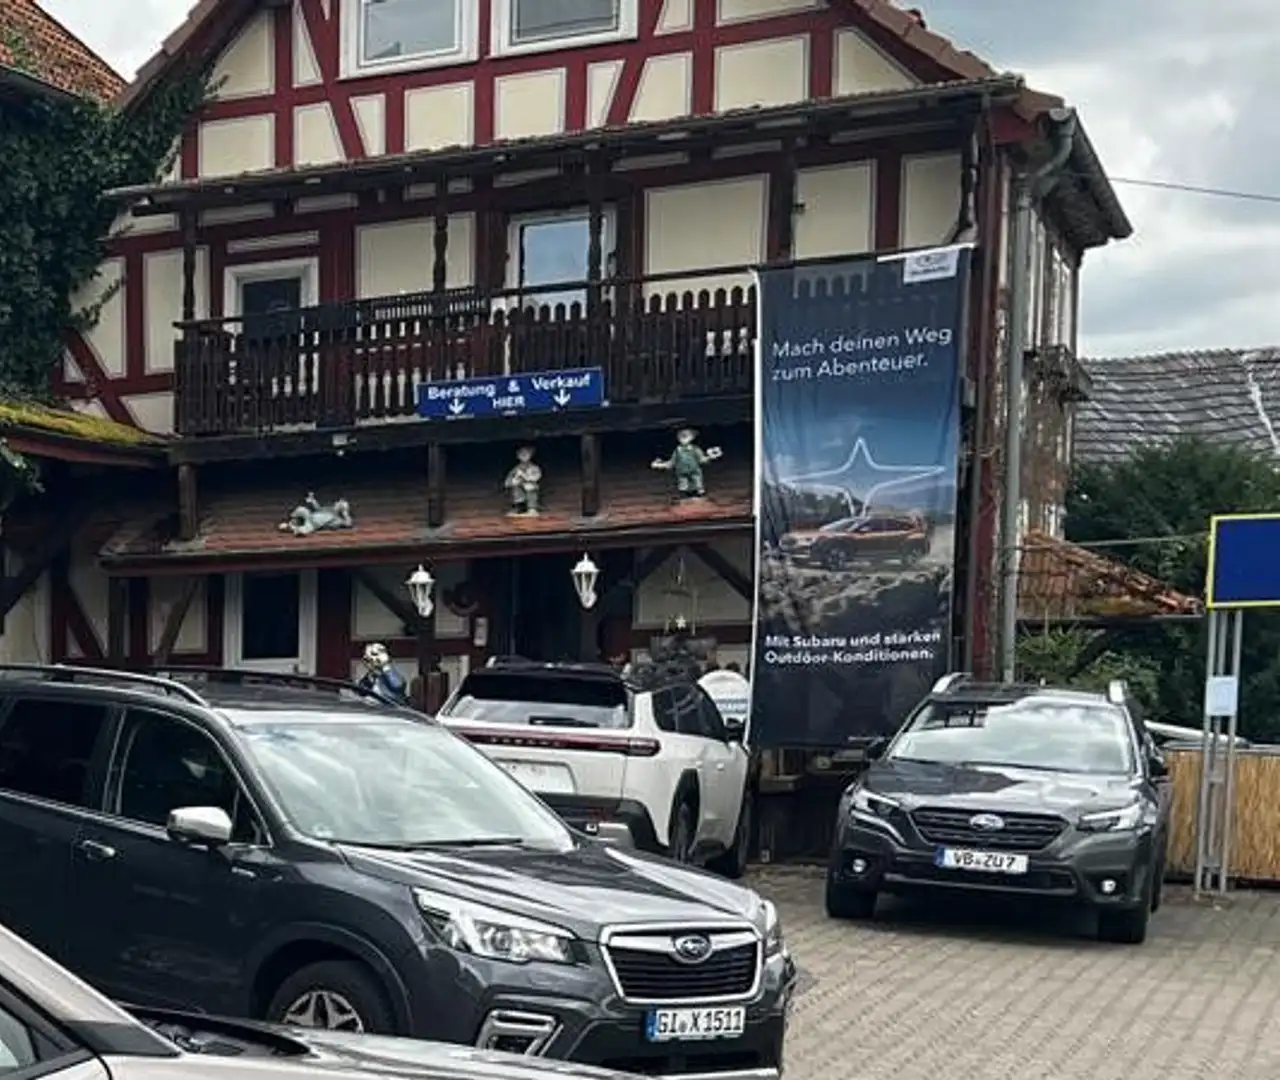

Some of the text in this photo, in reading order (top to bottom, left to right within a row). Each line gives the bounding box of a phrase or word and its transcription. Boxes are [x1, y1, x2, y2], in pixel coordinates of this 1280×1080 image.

[772, 326, 953, 358] Mach deinen Weg
[771, 352, 929, 382] zum Abenteuer.
[427, 373, 591, 400] Beratung & Verkauf
[492, 395, 526, 409] HIER
[764, 630, 941, 648] Mit Subaru und starken
[954, 851, 974, 866] VB
[658, 1012, 678, 1033] GI
[703, 1010, 742, 1032] 1511
